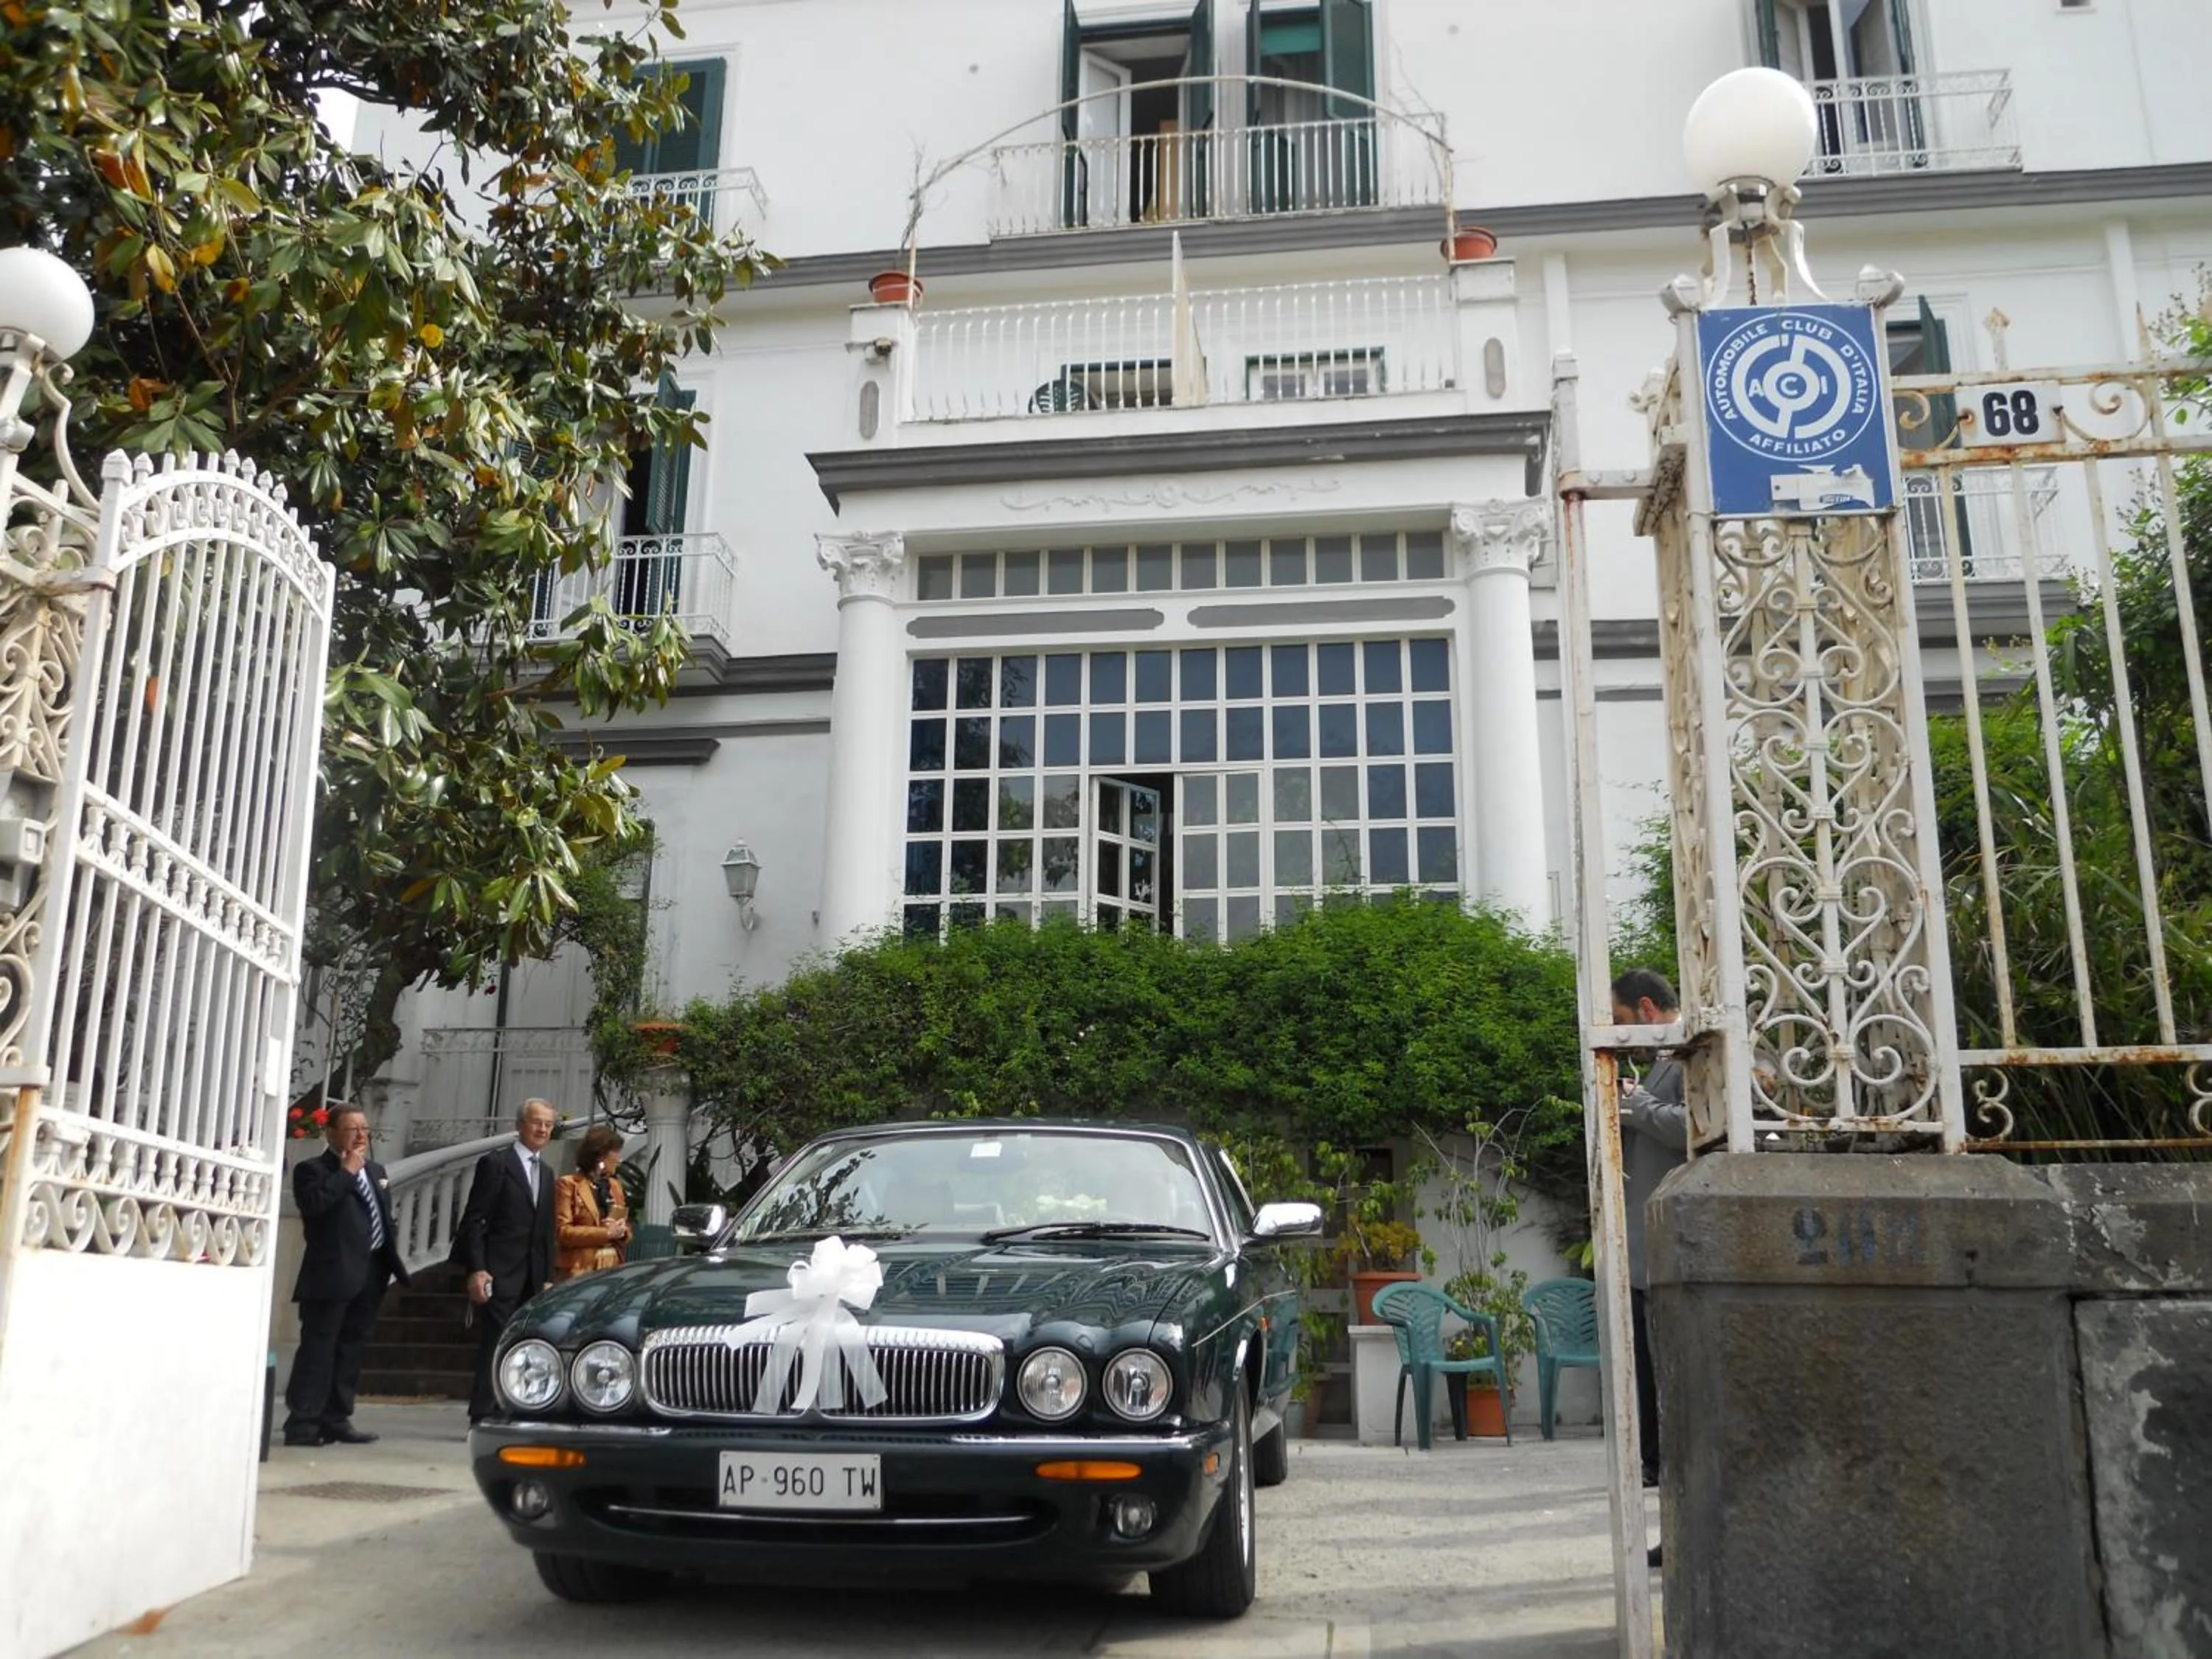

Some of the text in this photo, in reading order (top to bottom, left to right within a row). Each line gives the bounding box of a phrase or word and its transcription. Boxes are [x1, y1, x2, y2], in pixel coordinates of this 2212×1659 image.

[1715, 319, 1869, 420] AUTOMOBILE CLUB D'ITALIA
[1982, 389, 2039, 437] 68
[1749, 429, 1846, 454] AFFILIATO
[774, 1466, 824, 1496] 960
[842, 1467, 876, 1497] TW
